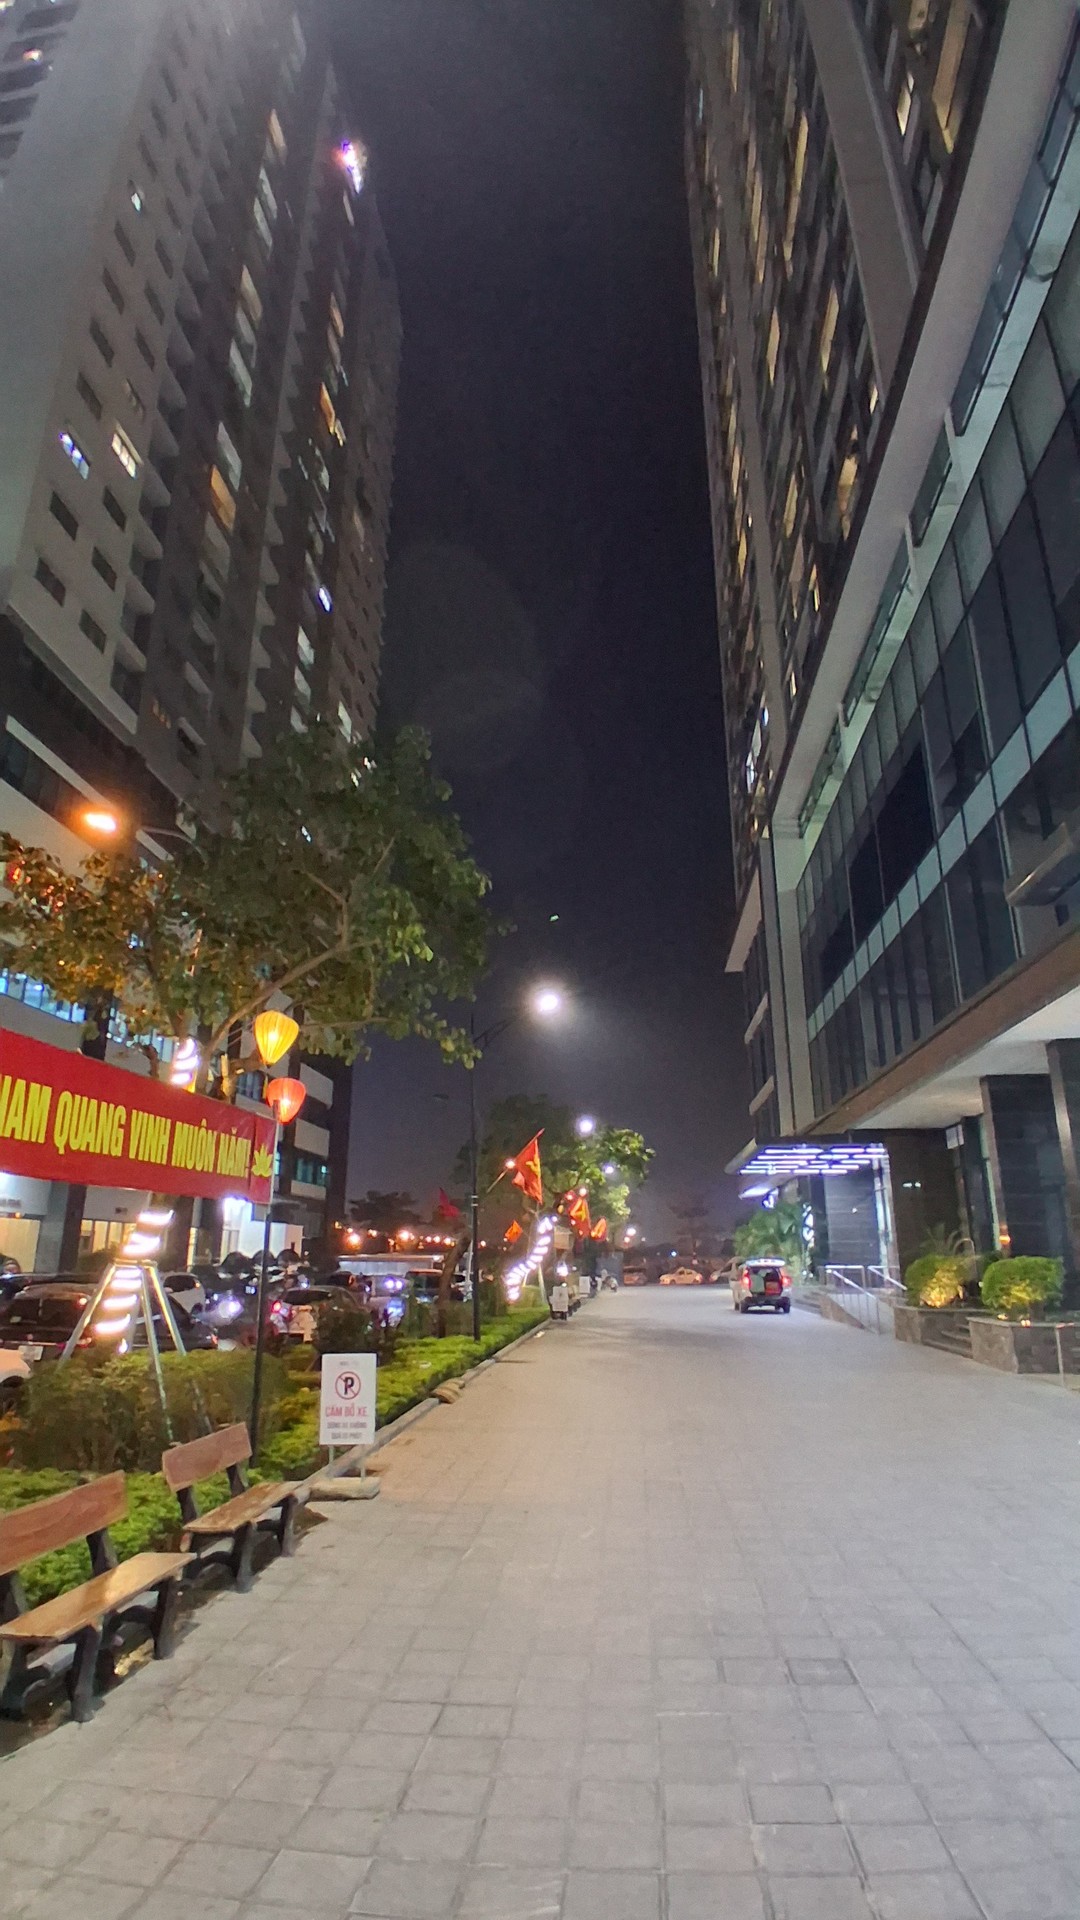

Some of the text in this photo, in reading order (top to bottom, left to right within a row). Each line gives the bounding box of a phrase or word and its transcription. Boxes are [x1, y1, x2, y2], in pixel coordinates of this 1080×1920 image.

[54, 1090, 127, 1157] QUANG
[129, 1109, 171, 1165] VINH
[171, 1118, 218, 1173] MUÔN
[344, 1376, 354, 1395] P
